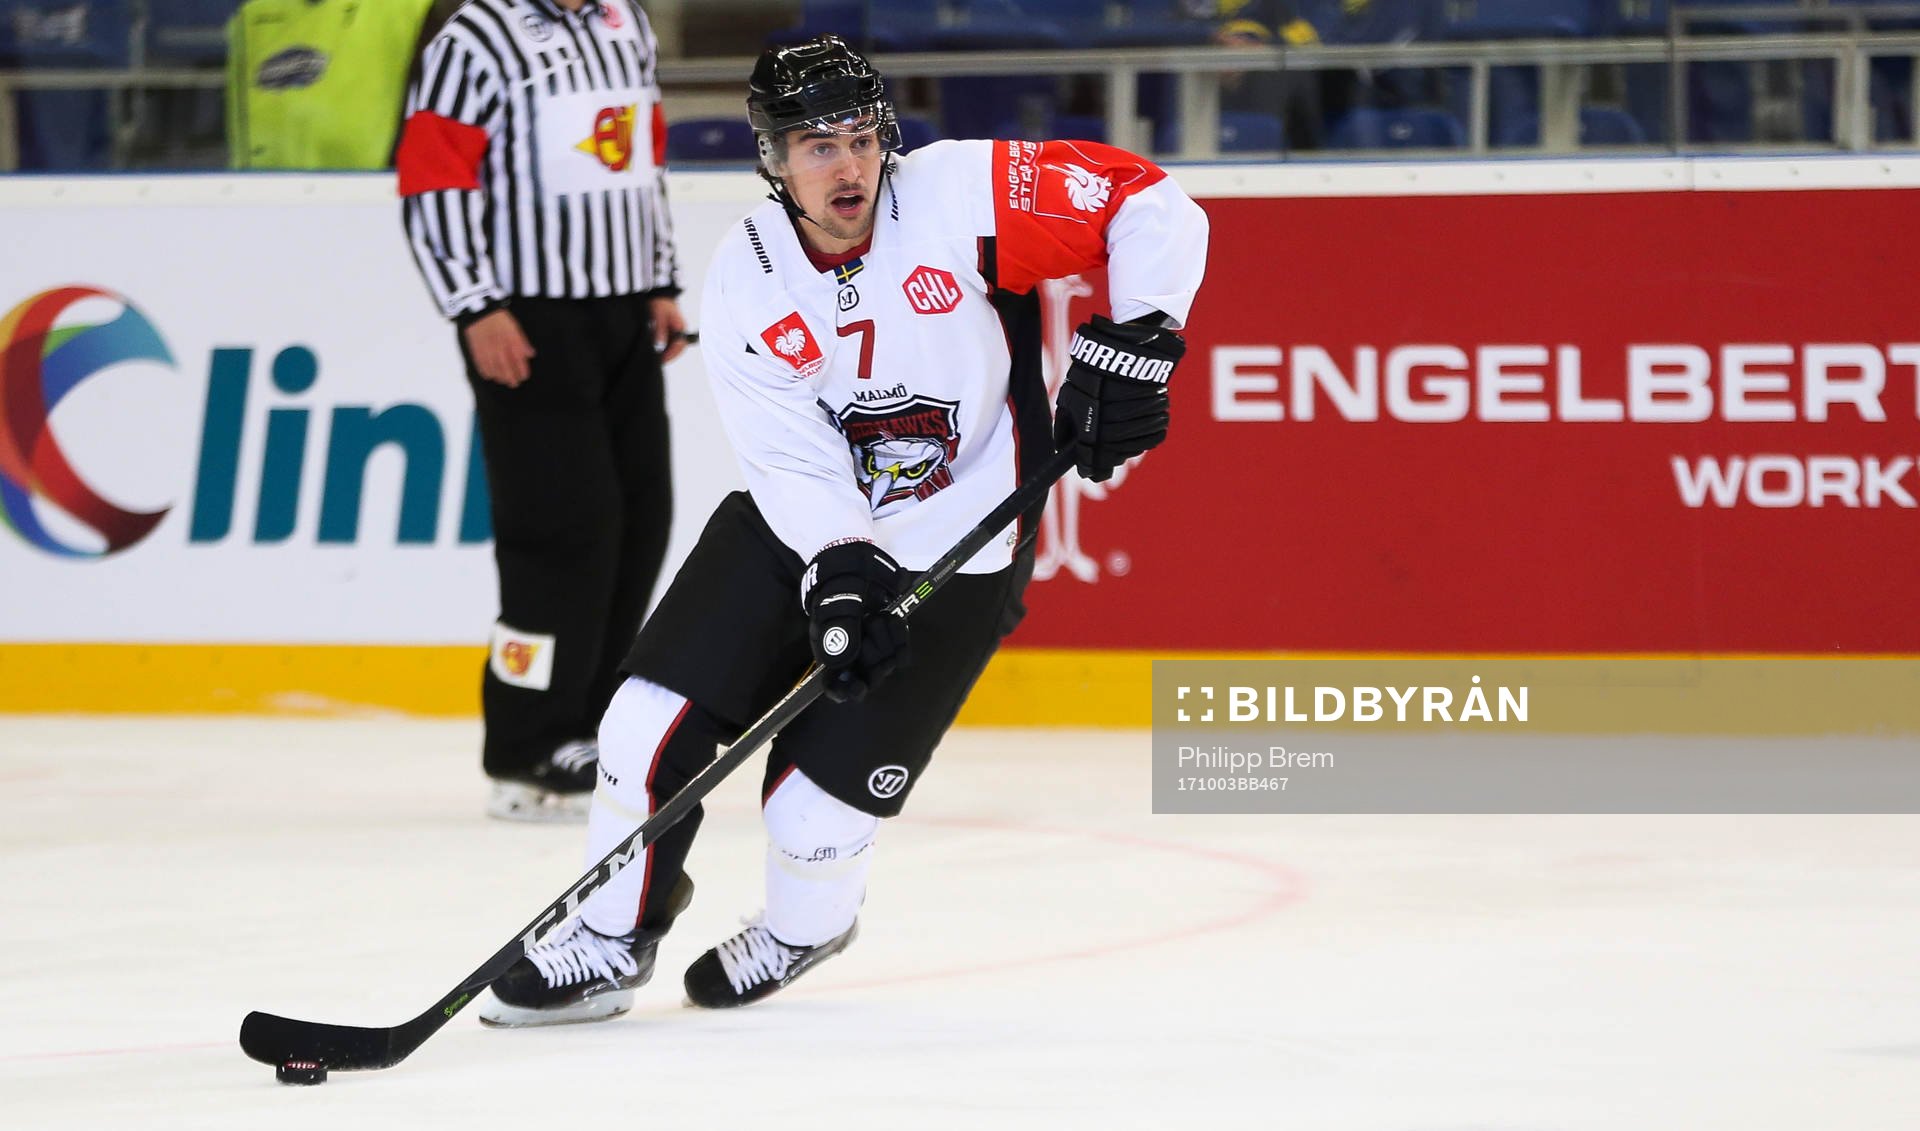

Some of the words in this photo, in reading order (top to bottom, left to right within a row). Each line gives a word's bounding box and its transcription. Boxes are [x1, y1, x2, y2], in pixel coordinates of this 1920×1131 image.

[906, 270, 959, 311] CHL
[836, 318, 876, 380] 7
[1070, 331, 1174, 384] WARRIOR
[853, 382, 908, 403] MALMÖ
[1671, 454, 1920, 508] WORK
[519, 831, 644, 956] CCM
